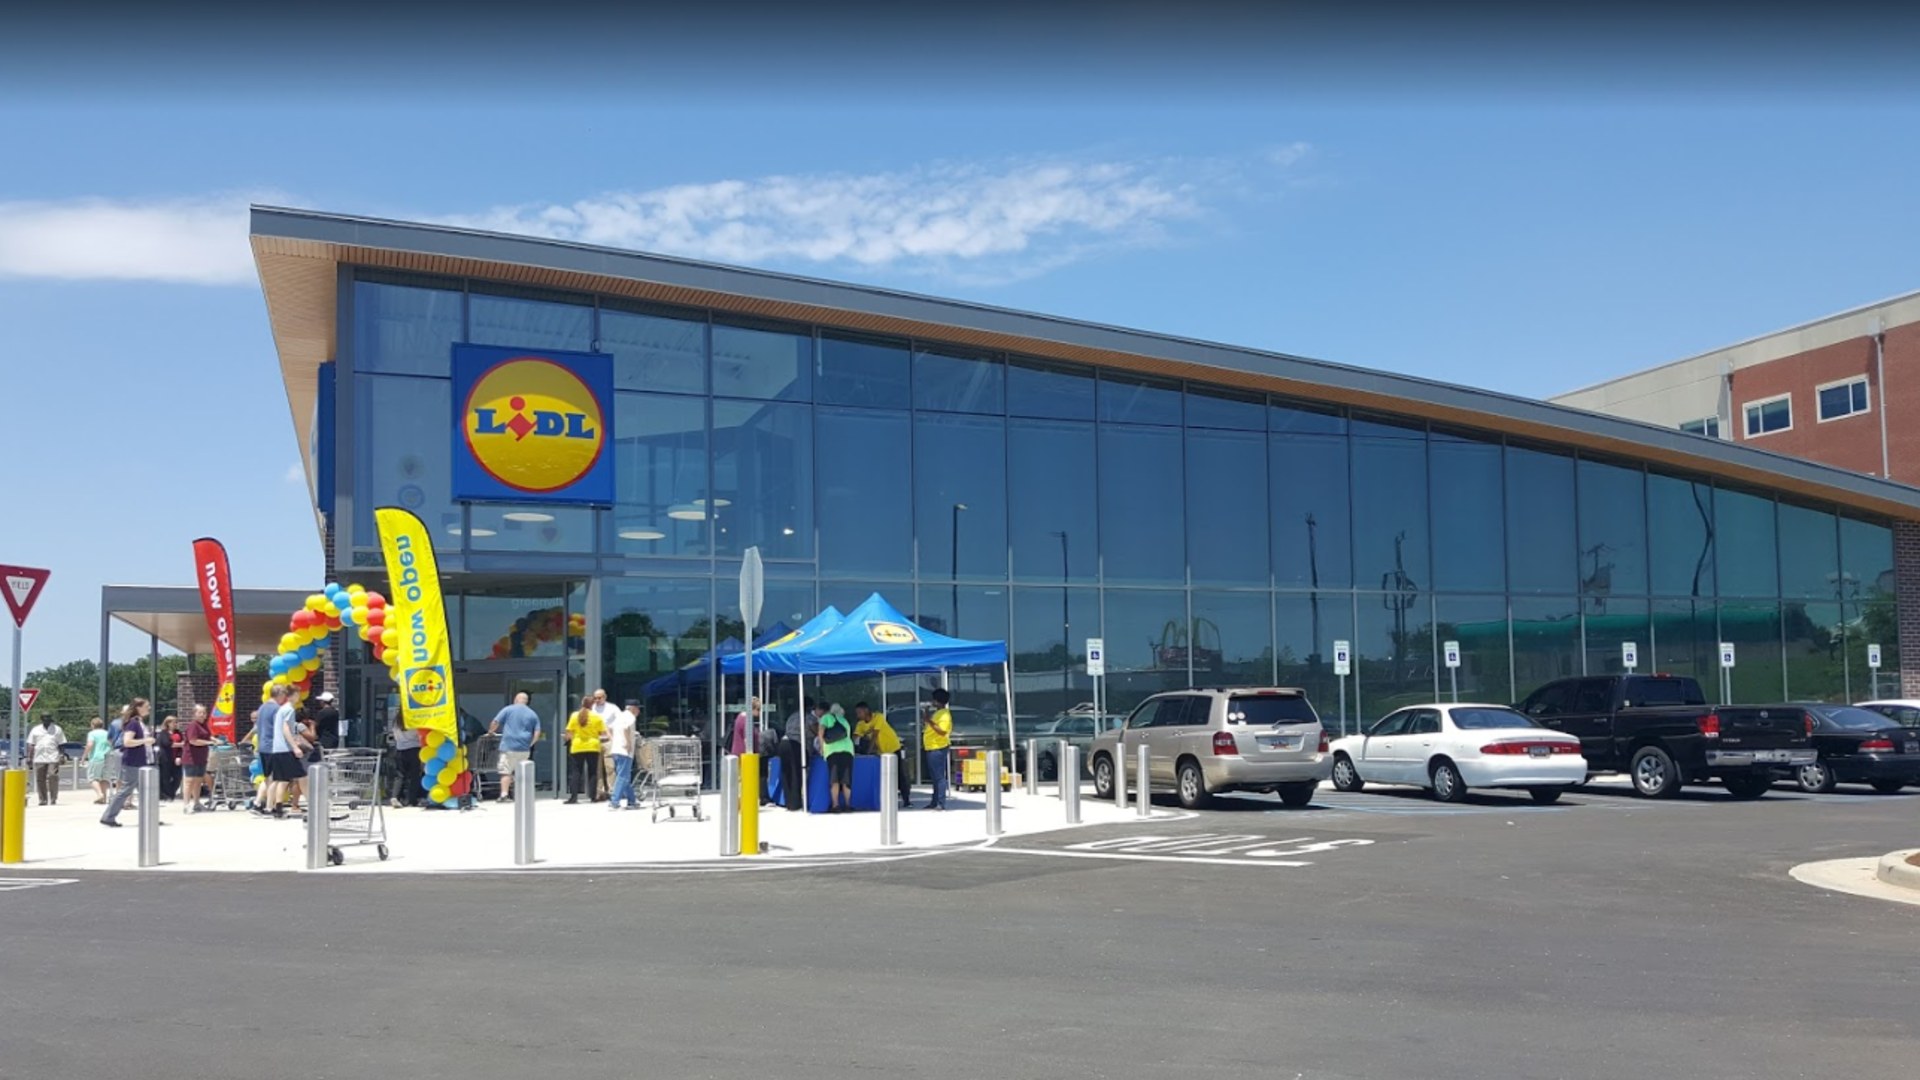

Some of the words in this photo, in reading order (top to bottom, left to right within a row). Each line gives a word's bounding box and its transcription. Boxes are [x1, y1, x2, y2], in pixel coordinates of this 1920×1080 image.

[11, 581, 30, 590] YIELD
[205, 561, 222, 609] now
[217, 617, 233, 676] open
[1063, 833, 1375, 857] STOP
